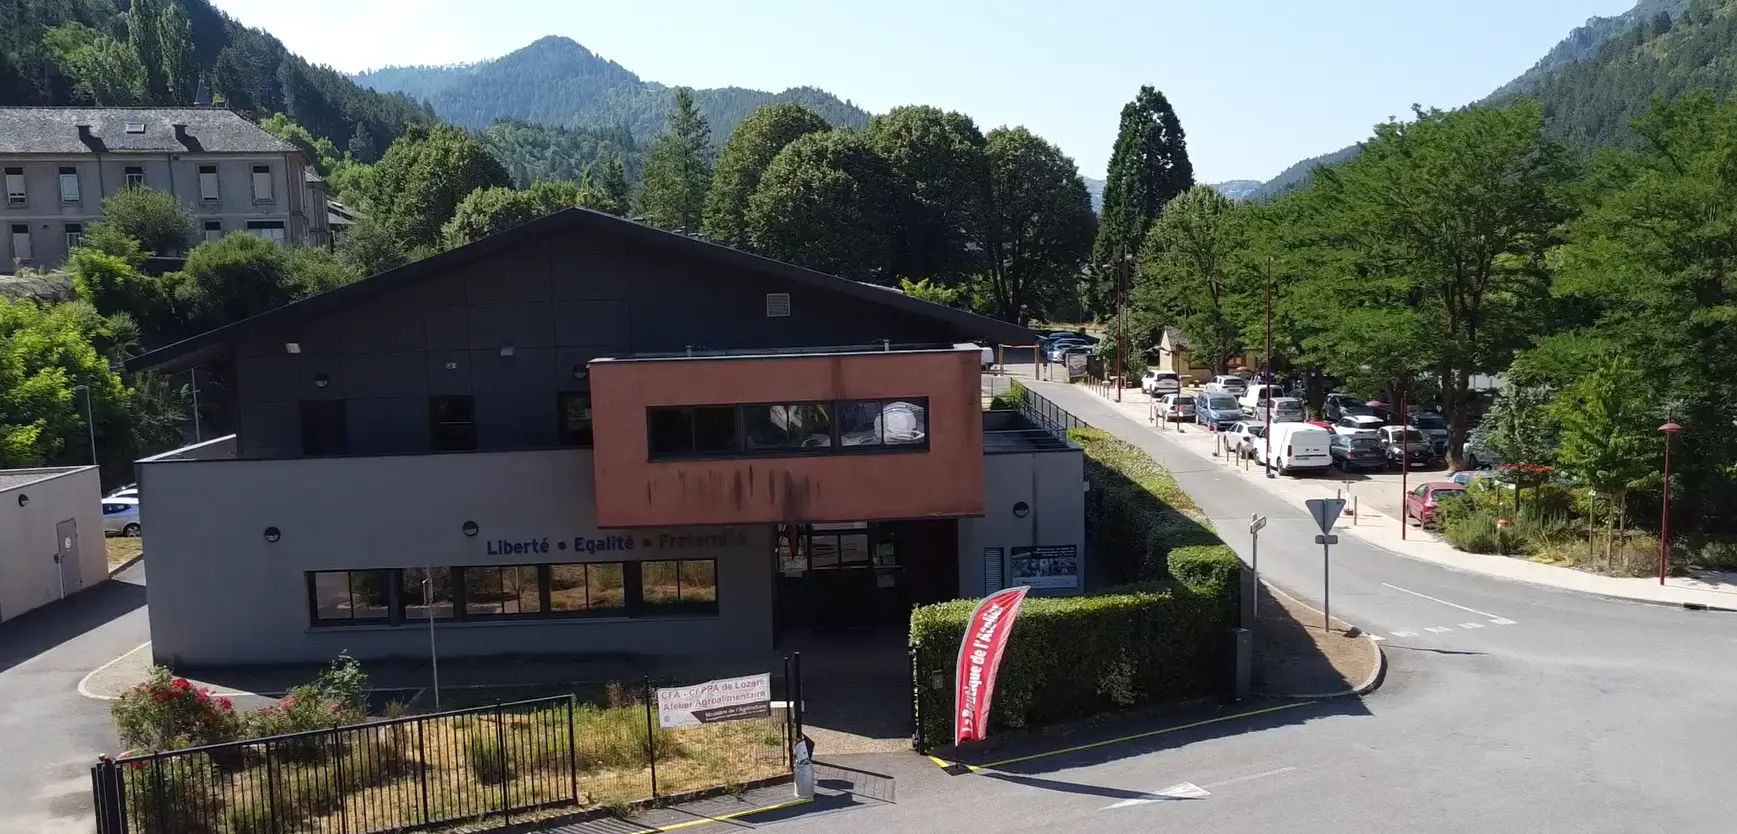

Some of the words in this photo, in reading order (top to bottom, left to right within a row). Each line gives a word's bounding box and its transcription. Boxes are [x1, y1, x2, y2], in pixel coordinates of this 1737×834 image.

[487, 537, 550, 555] Liberté
[574, 535, 635, 554] Egalité
[970, 649, 987, 665] de
[661, 690, 681, 700] CFA
[721, 682, 732, 691] de
[663, 702, 692, 711] Atelier
[695, 691, 766, 708] Agroalimentaire
